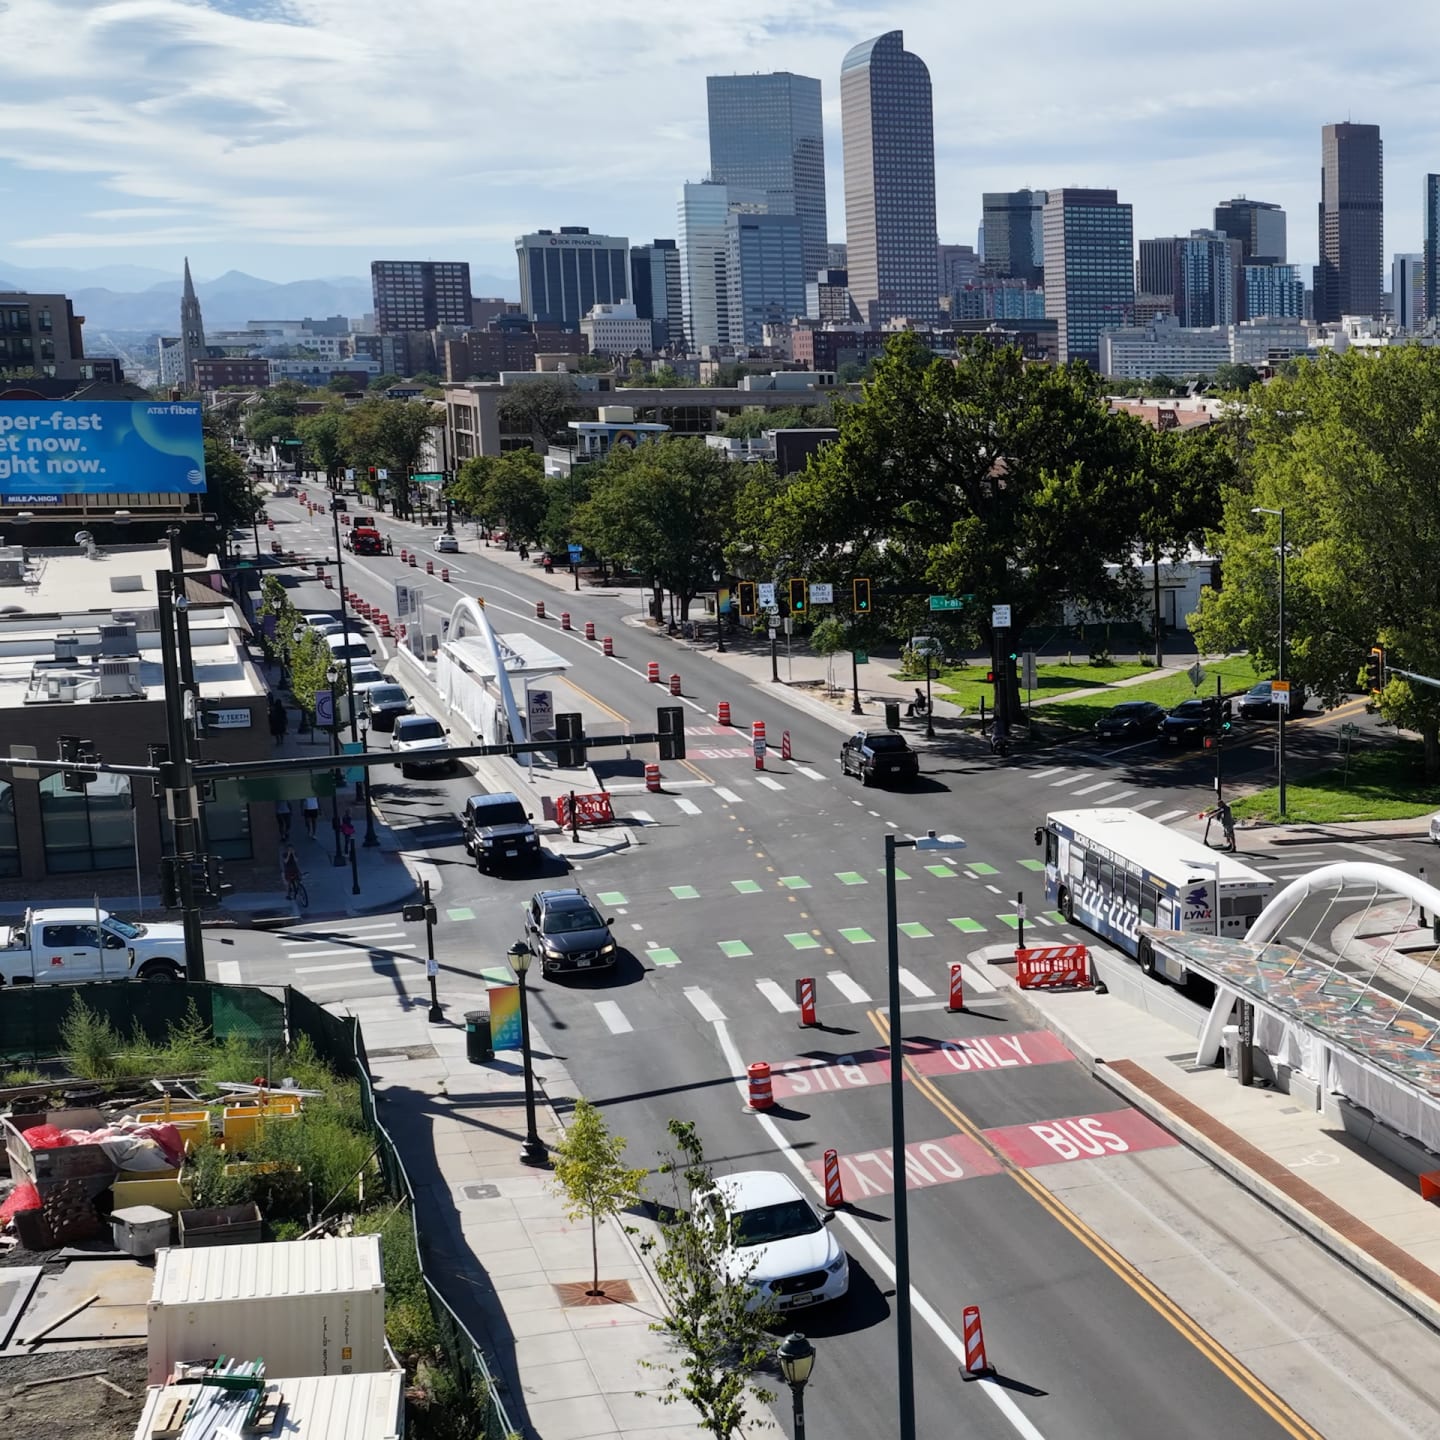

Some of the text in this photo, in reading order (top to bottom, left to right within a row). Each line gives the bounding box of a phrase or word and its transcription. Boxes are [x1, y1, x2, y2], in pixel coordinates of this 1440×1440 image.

[147, 405, 198, 415] AT&T fiber
[0, 411, 103, 432] per-fast
[27, 437, 87, 452] now.
[47, 458, 107, 474] now.
[684, 726, 717, 736] NLY
[700, 748, 750, 759] BUS
[1184, 909, 1213, 920] LYNX
[939, 1035, 1032, 1071] ONLY
[781, 1055, 868, 1094] BUS
[1028, 1117, 1129, 1160] BUS
[843, 1143, 964, 1196] ONLY
